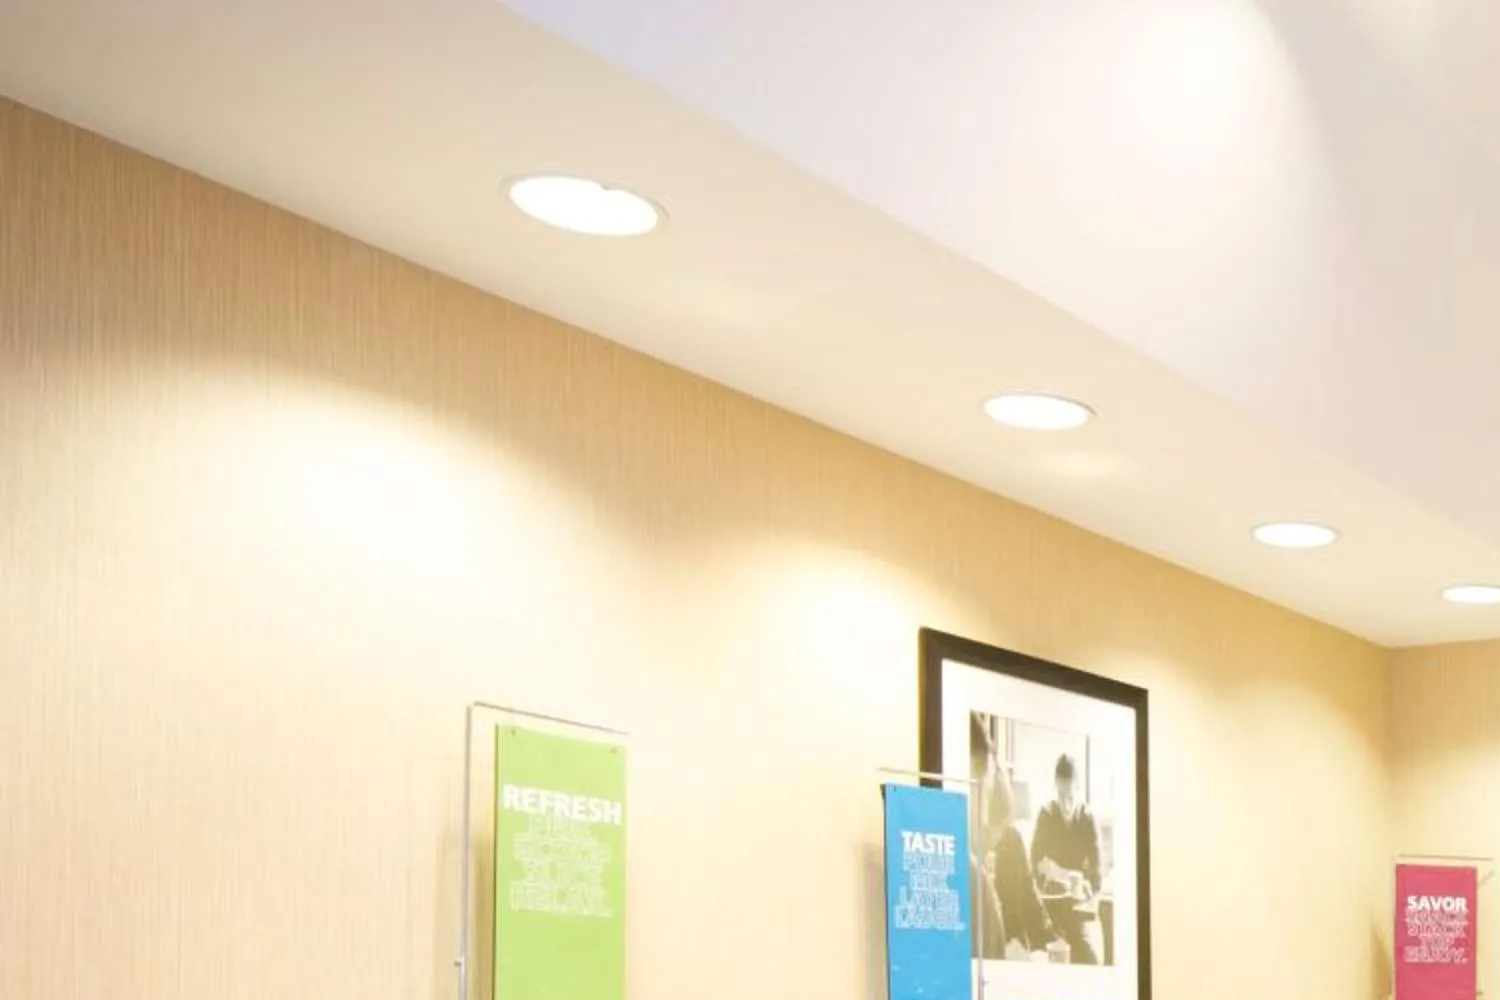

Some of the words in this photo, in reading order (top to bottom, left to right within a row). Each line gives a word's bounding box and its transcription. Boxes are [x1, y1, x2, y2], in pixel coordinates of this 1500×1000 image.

[502, 783, 622, 825] REFRESH
[901, 831, 956, 856] TASTE
[1407, 896, 1467, 911] SAVOR
